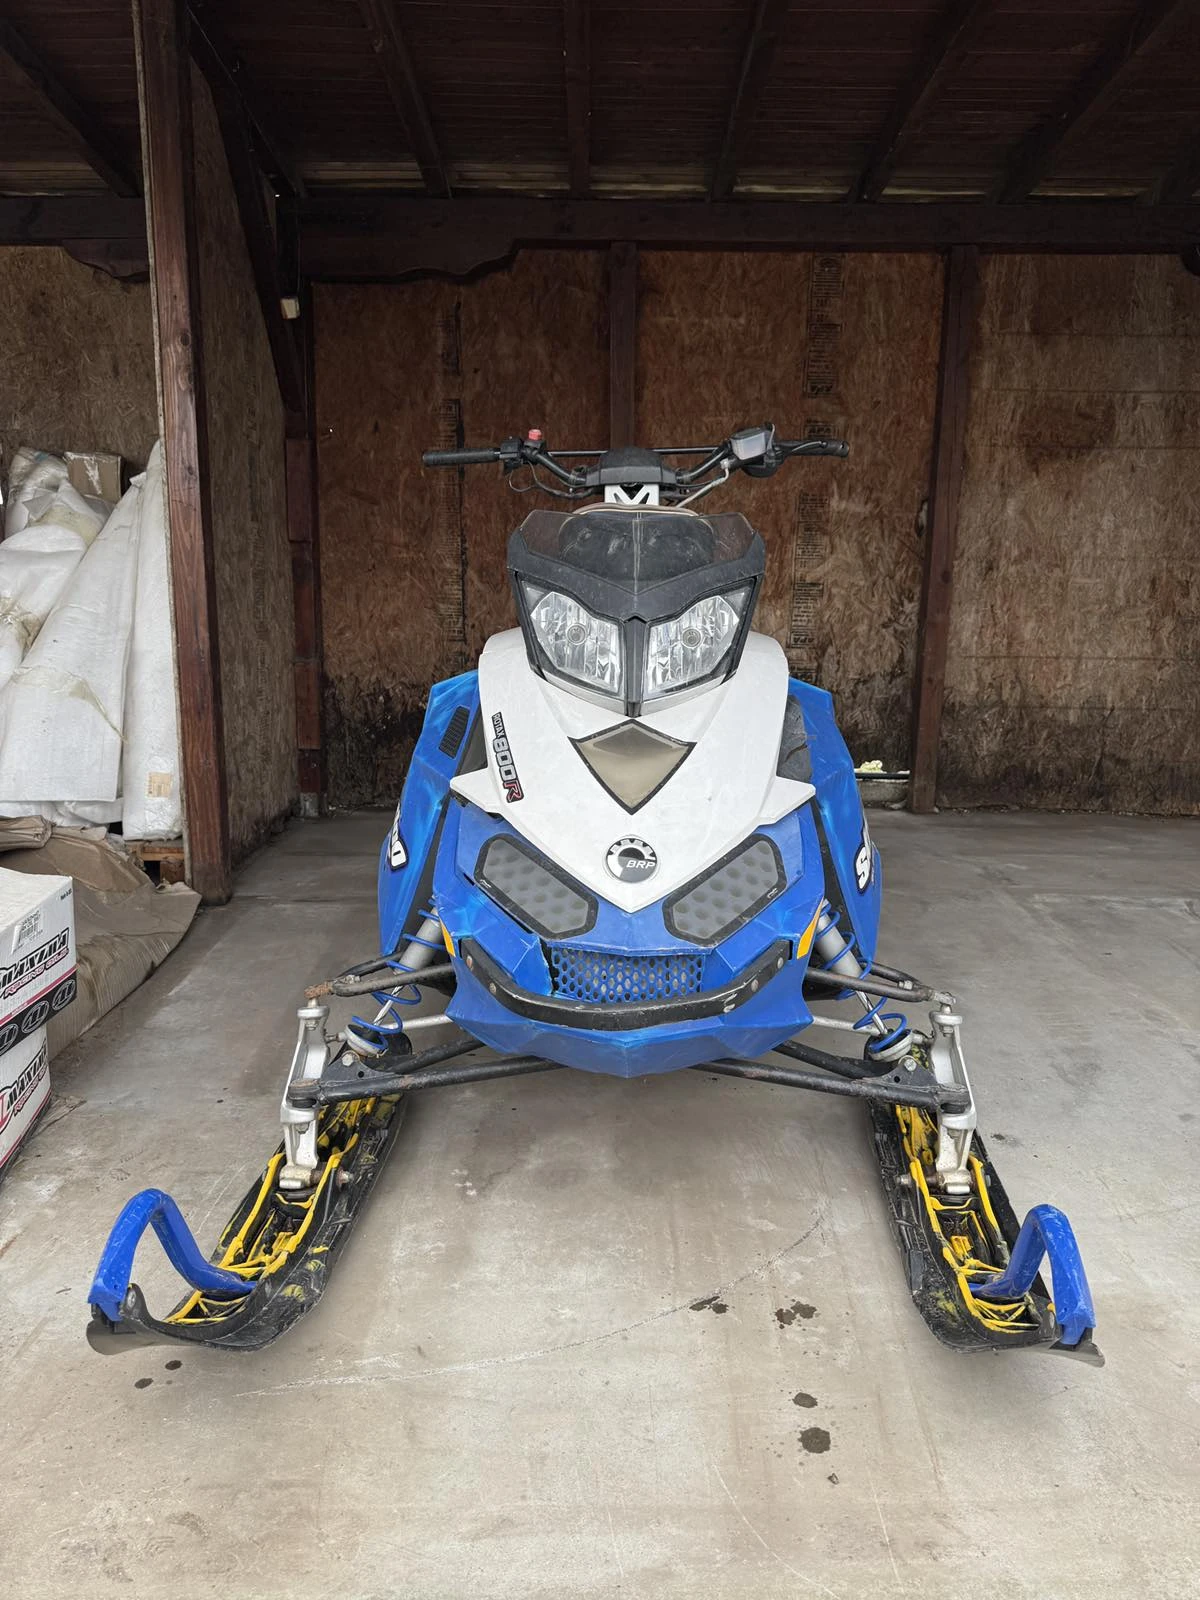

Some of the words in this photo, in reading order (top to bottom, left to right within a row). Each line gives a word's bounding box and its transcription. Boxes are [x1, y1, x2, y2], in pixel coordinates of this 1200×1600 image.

[492, 712, 506, 739] ROTAX
[493, 738, 524, 803] 800R
[626, 860, 655, 869] BRP
